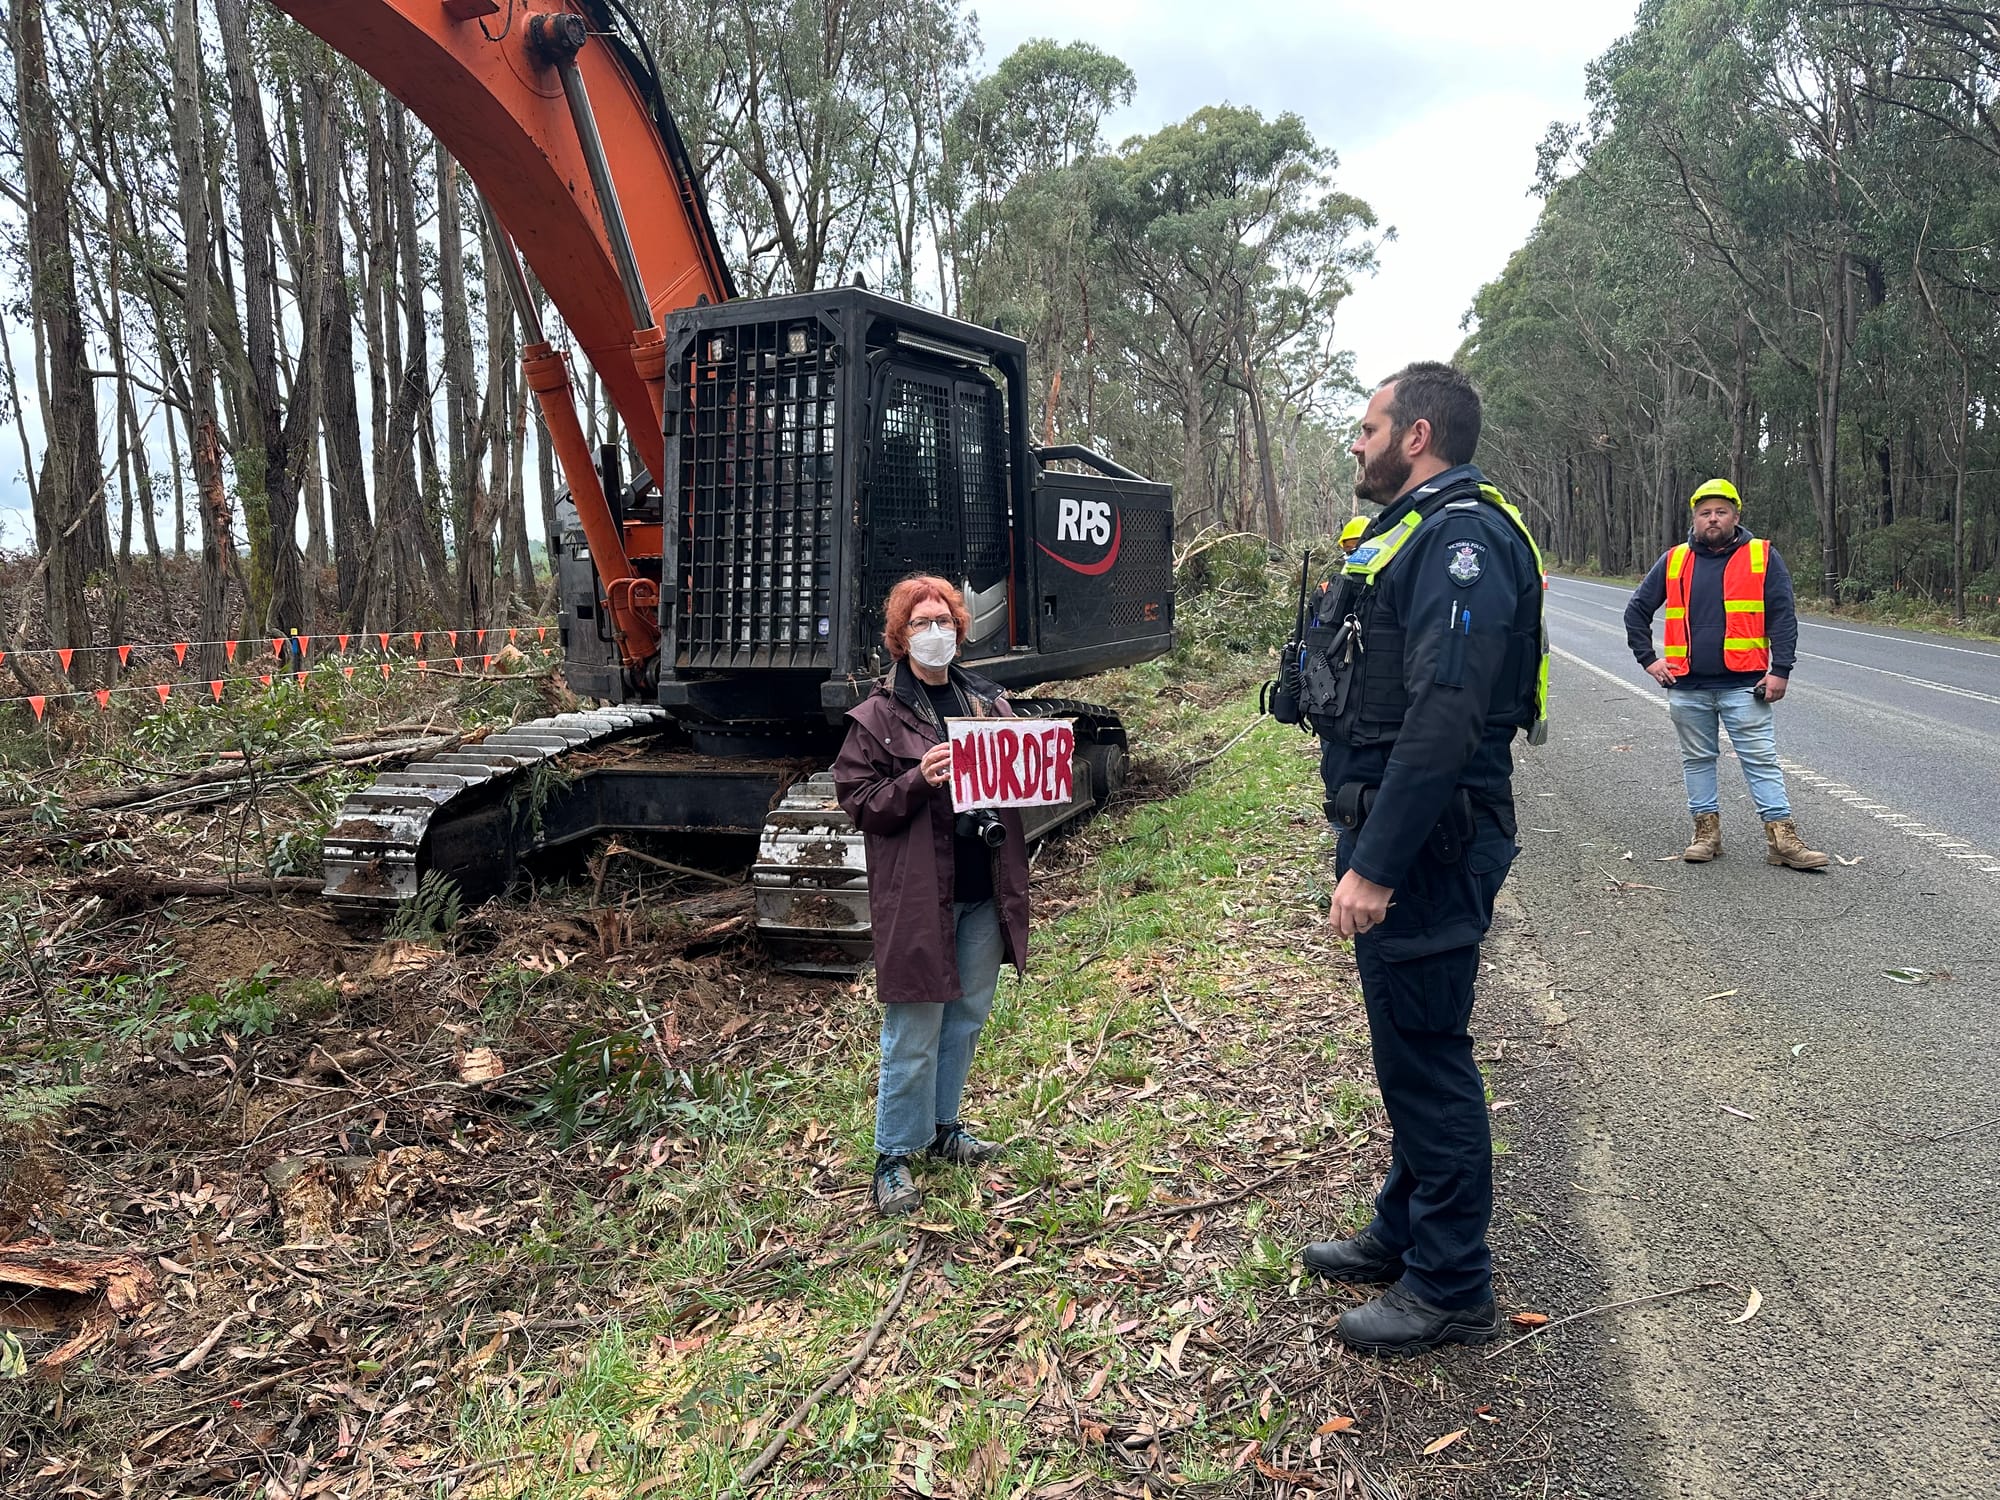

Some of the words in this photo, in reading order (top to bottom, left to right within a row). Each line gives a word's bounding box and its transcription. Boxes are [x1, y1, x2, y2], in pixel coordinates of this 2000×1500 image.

[1057, 498, 1111, 546] RPS
[1448, 541, 1470, 550] VICTORIA
[1471, 543, 1486, 552] POLICE
[951, 726, 1073, 804] MURDER
